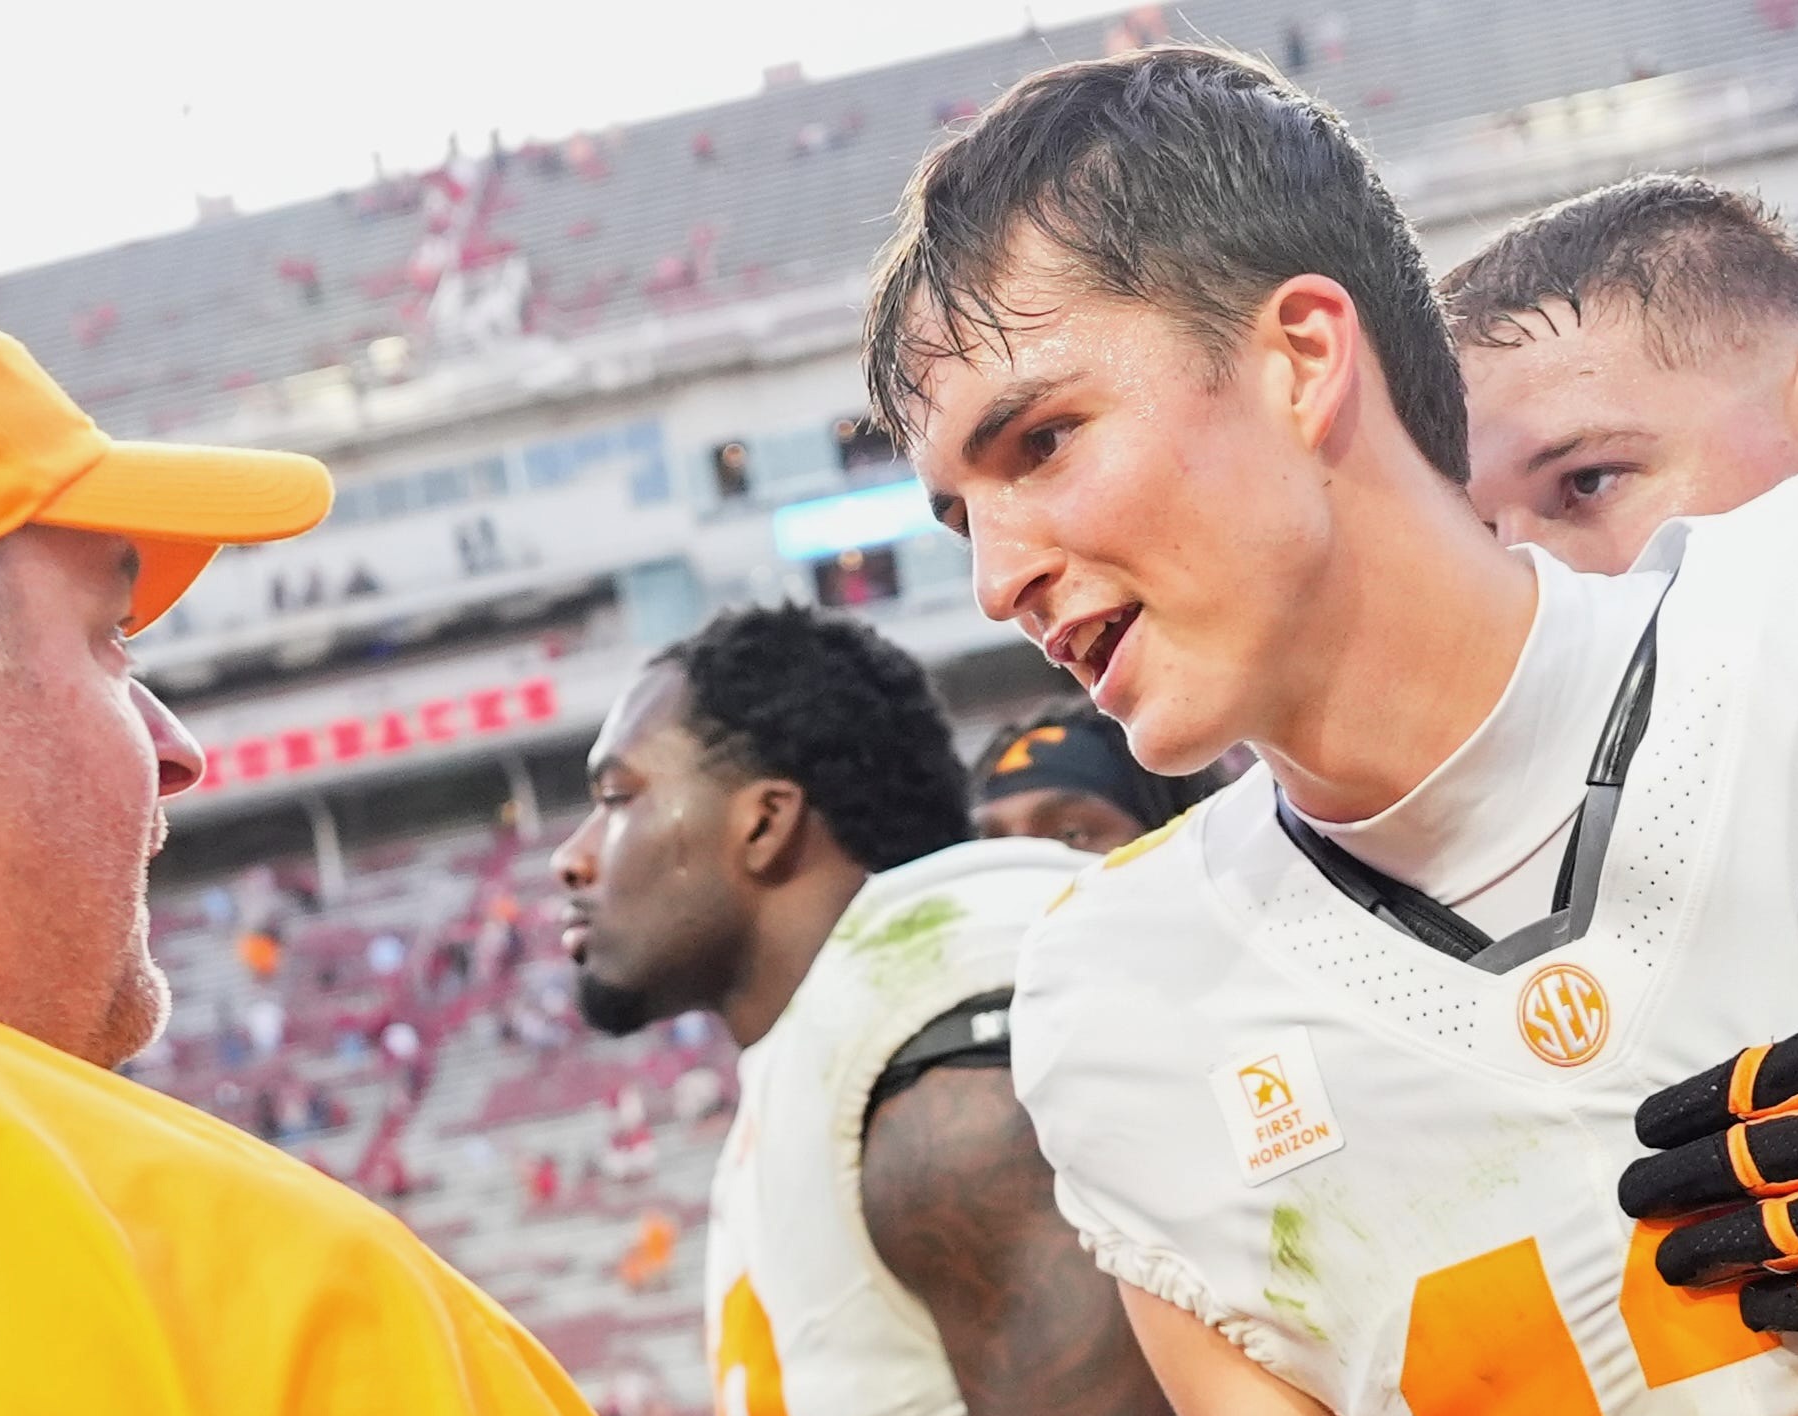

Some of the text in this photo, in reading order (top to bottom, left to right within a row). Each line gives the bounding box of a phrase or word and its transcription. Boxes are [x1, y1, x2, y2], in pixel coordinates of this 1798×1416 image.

[1524, 972, 1602, 1061] SEC
[1247, 1121, 1330, 1169] HORIZON
[1256, 1109, 1302, 1143] FIRST
